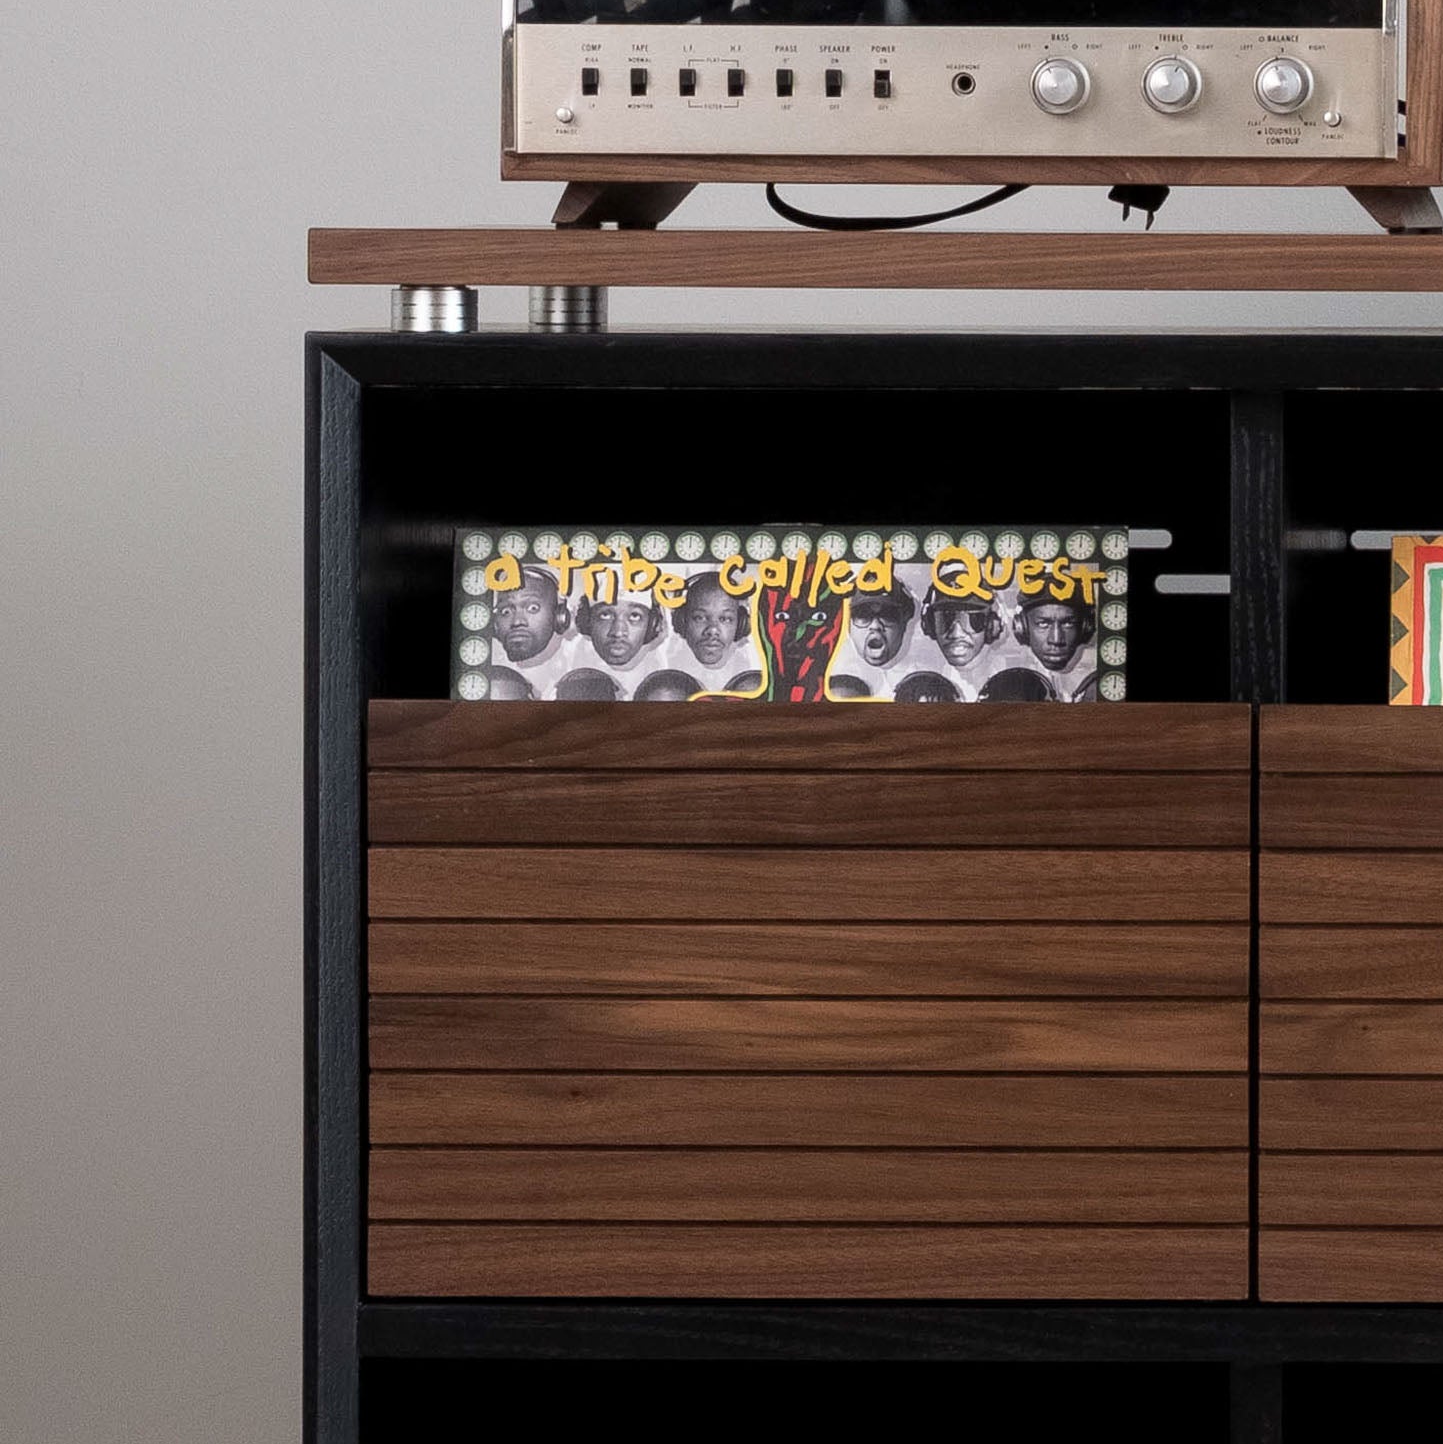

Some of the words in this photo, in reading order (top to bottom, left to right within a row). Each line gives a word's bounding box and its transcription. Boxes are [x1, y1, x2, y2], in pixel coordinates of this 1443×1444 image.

[1051, 33, 1070, 42] BASS
[1159, 34, 1184, 43] TREBLE
[1267, 35, 1299, 43] BALANCE
[581, 44, 602, 52] COMP
[631, 44, 649, 52] TAPE
[775, 45, 798, 53] PHASE
[1264, 127, 1302, 135] LOUDNESS
[1266, 137, 1300, 146] CONTOUR
[484, 552, 522, 591] a
[548, 544, 687, 609] tribe
[719, 541, 892, 608] called
[931, 545, 1107, 605] Quest
